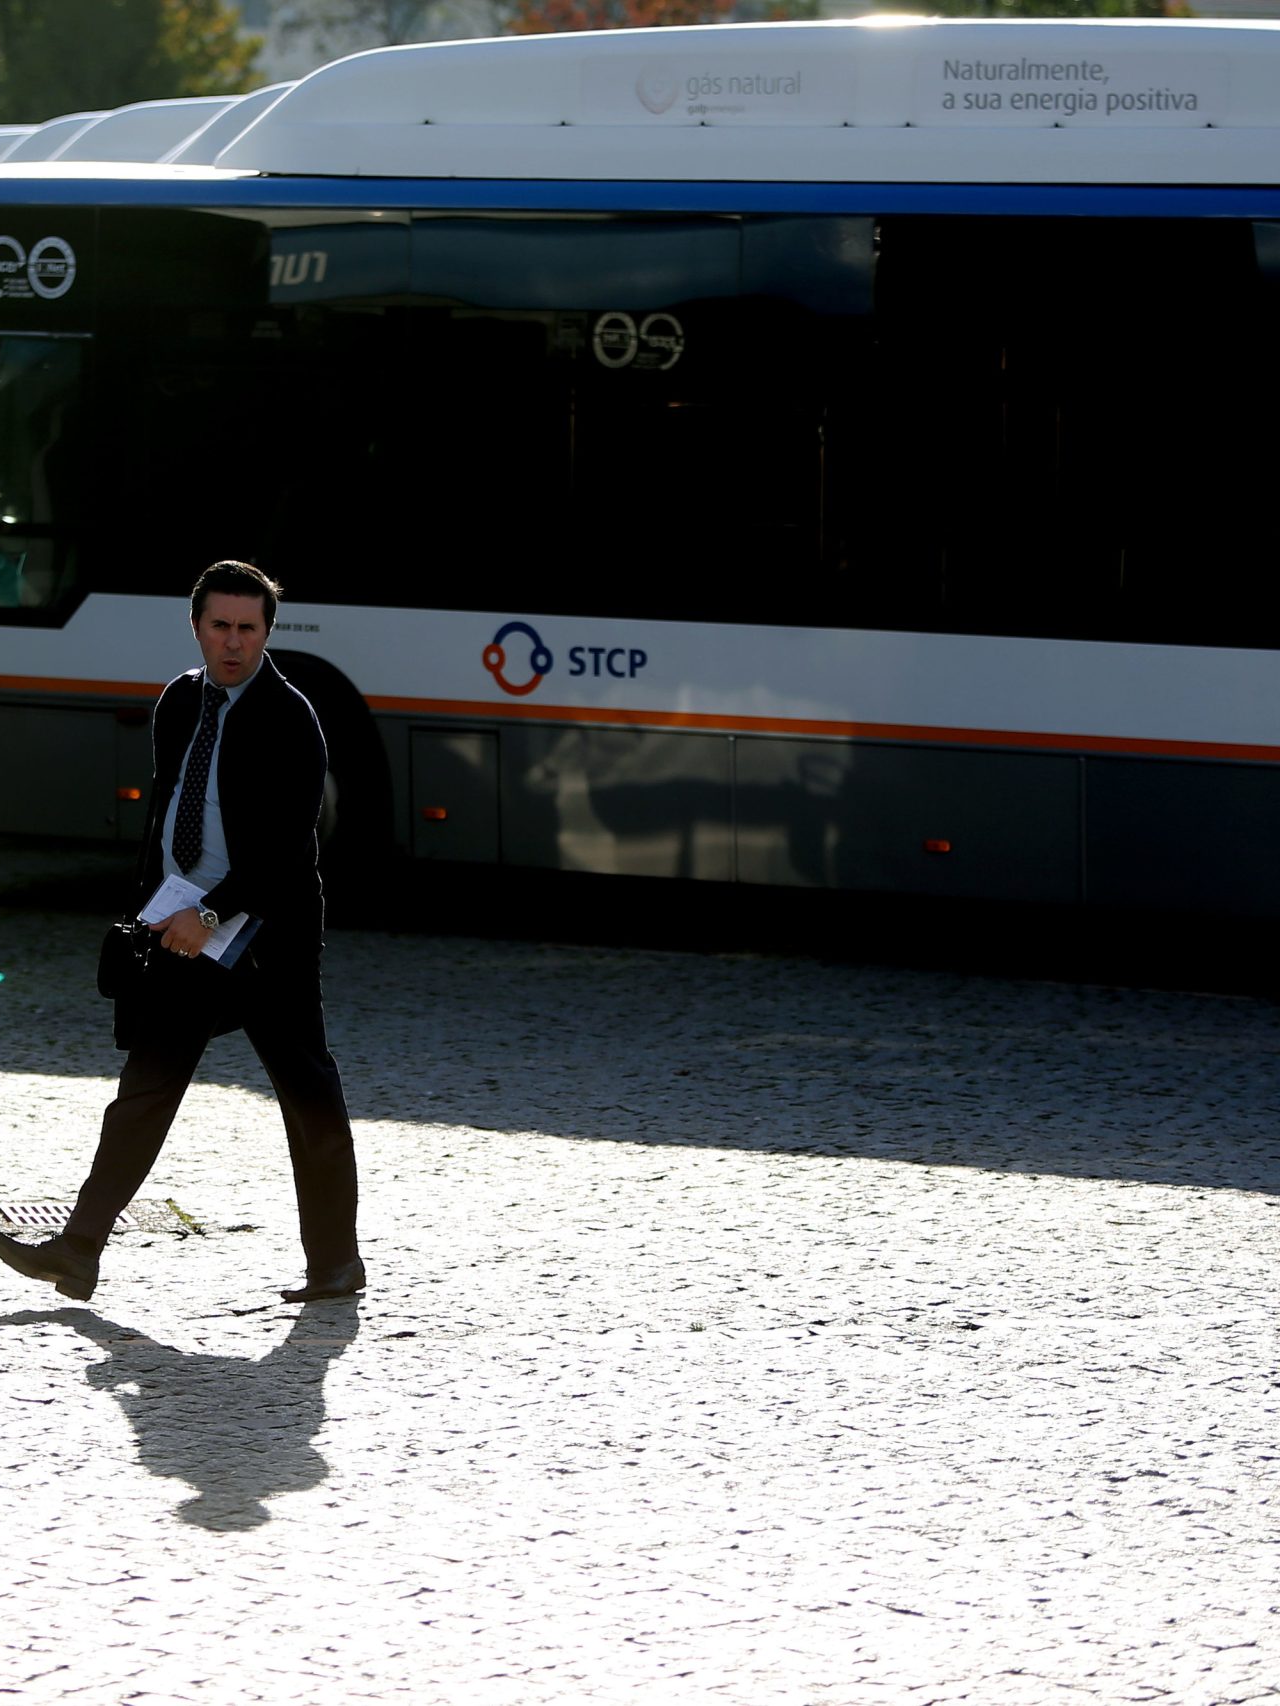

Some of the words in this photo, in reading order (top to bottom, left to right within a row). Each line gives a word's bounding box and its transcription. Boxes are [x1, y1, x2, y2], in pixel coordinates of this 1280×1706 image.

[686, 72, 722, 100] gás
[728, 71, 801, 95] natural
[943, 59, 1109, 84] Naturalmente,
[942, 92, 955, 110] a
[963, 92, 1002, 110] sua
[1010, 88, 1098, 116] energia
[1106, 87, 1198, 116] positiva
[568, 646, 648, 678] STCP
